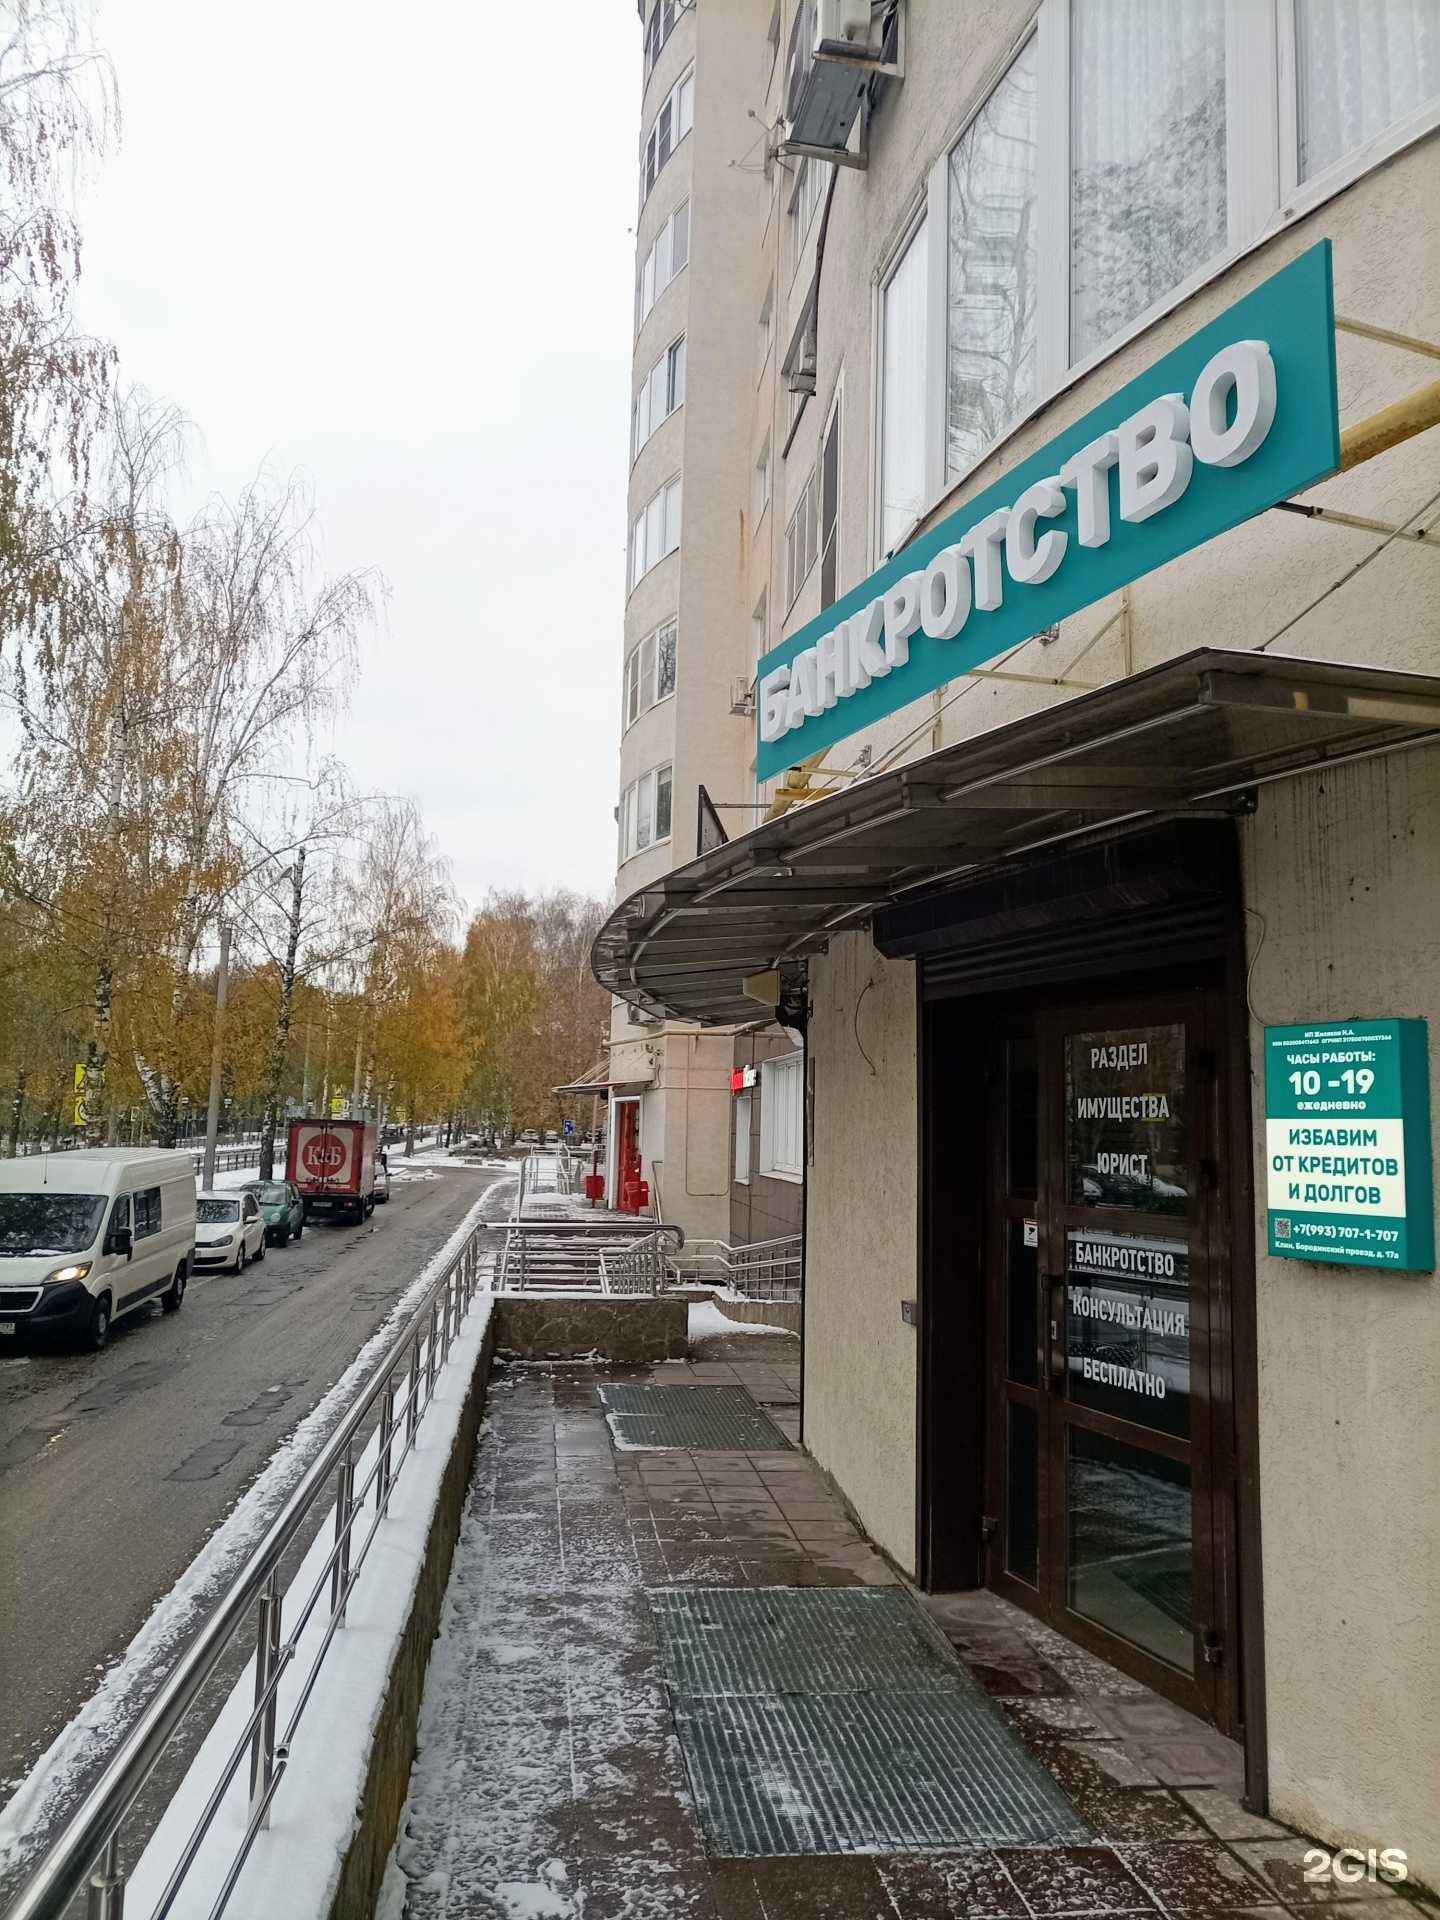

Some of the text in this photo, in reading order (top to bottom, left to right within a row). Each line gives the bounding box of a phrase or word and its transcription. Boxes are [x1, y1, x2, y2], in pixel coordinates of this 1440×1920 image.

[760, 339, 1277, 743] БАНКРОТСТВО
[1091, 1042, 1148, 1070] РАЗДЕЛ
[1286, 1051, 1376, 1065] ЧАСЫ РАБОТЫ:
[1077, 1095, 1169, 1122] ИМУЩЕСТВА
[1296, 1101, 1366, 1111] ежедневно
[1289, 1128, 1378, 1146] ИЗБАВИМ
[1096, 1152, 1148, 1177] ЮРИСТ
[1272, 1155, 1399, 1177] ОТ КРЕДИТОВ
[1288, 1183, 1382, 1204] И ДОЛГОВ
[1293, 1223, 1399, 1242] +7(993) 707-1-707
[1274, 1240, 1295, 1250] Клин,
[1295, 1242, 1345, 1254] Бородинский
[1075, 1241, 1175, 1277] БАНКРОТСТВО
[1072, 1293, 1186, 1336] КОНСУЛЬТАЦИЯ
[1083, 1356, 1166, 1400] БЕСПЛАТНО
